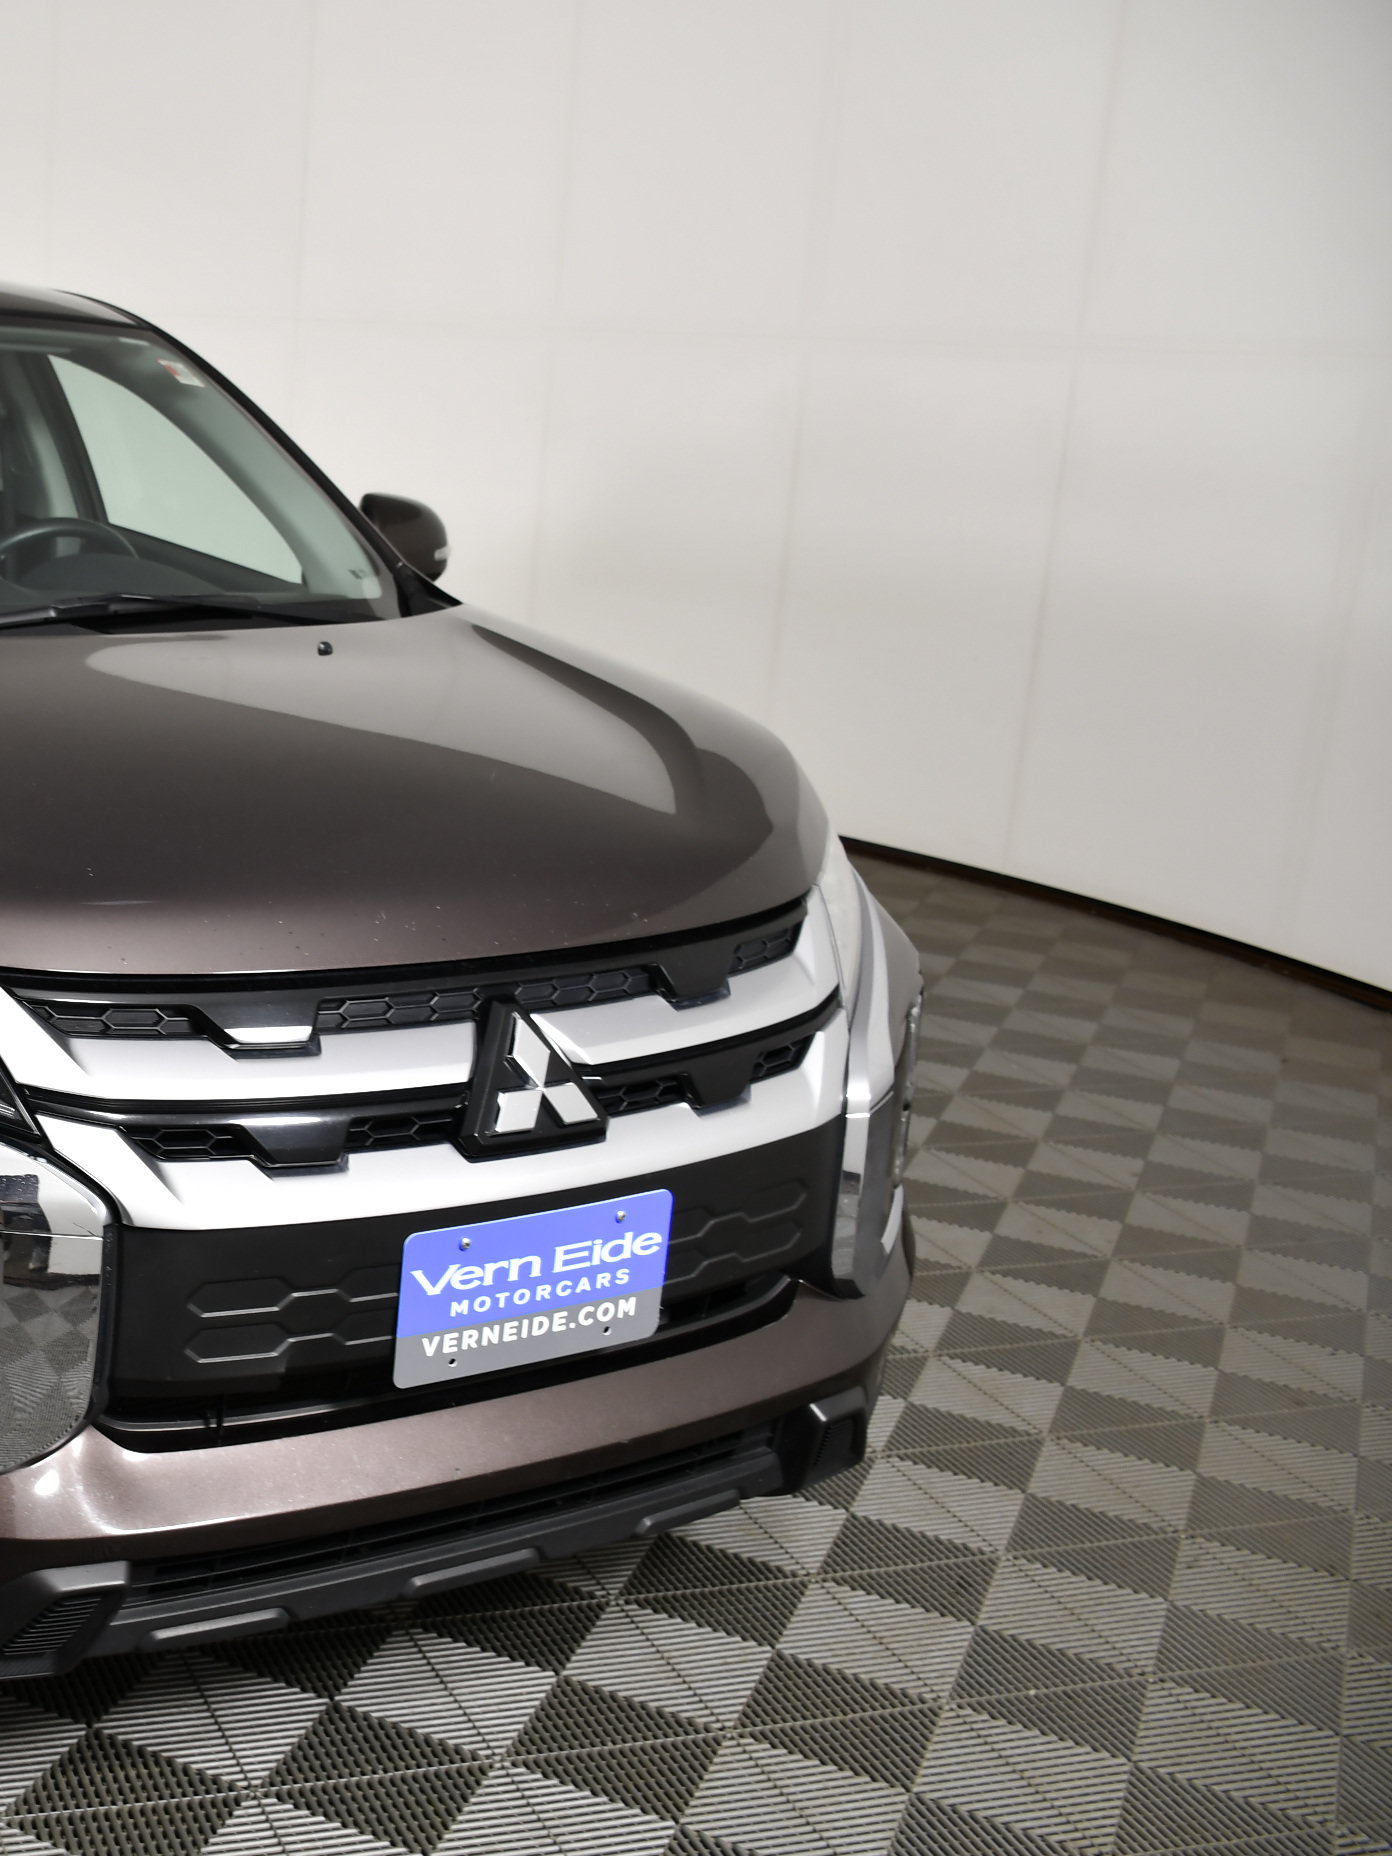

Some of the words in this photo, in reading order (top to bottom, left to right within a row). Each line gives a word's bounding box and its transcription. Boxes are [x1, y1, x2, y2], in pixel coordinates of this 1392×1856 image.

[410, 1255, 541, 1296] Vern
[553, 1231, 663, 1274] Eide
[449, 1268, 631, 1318] MOTORCARS
[421, 1296, 637, 1358] VERNEIDE.COM
